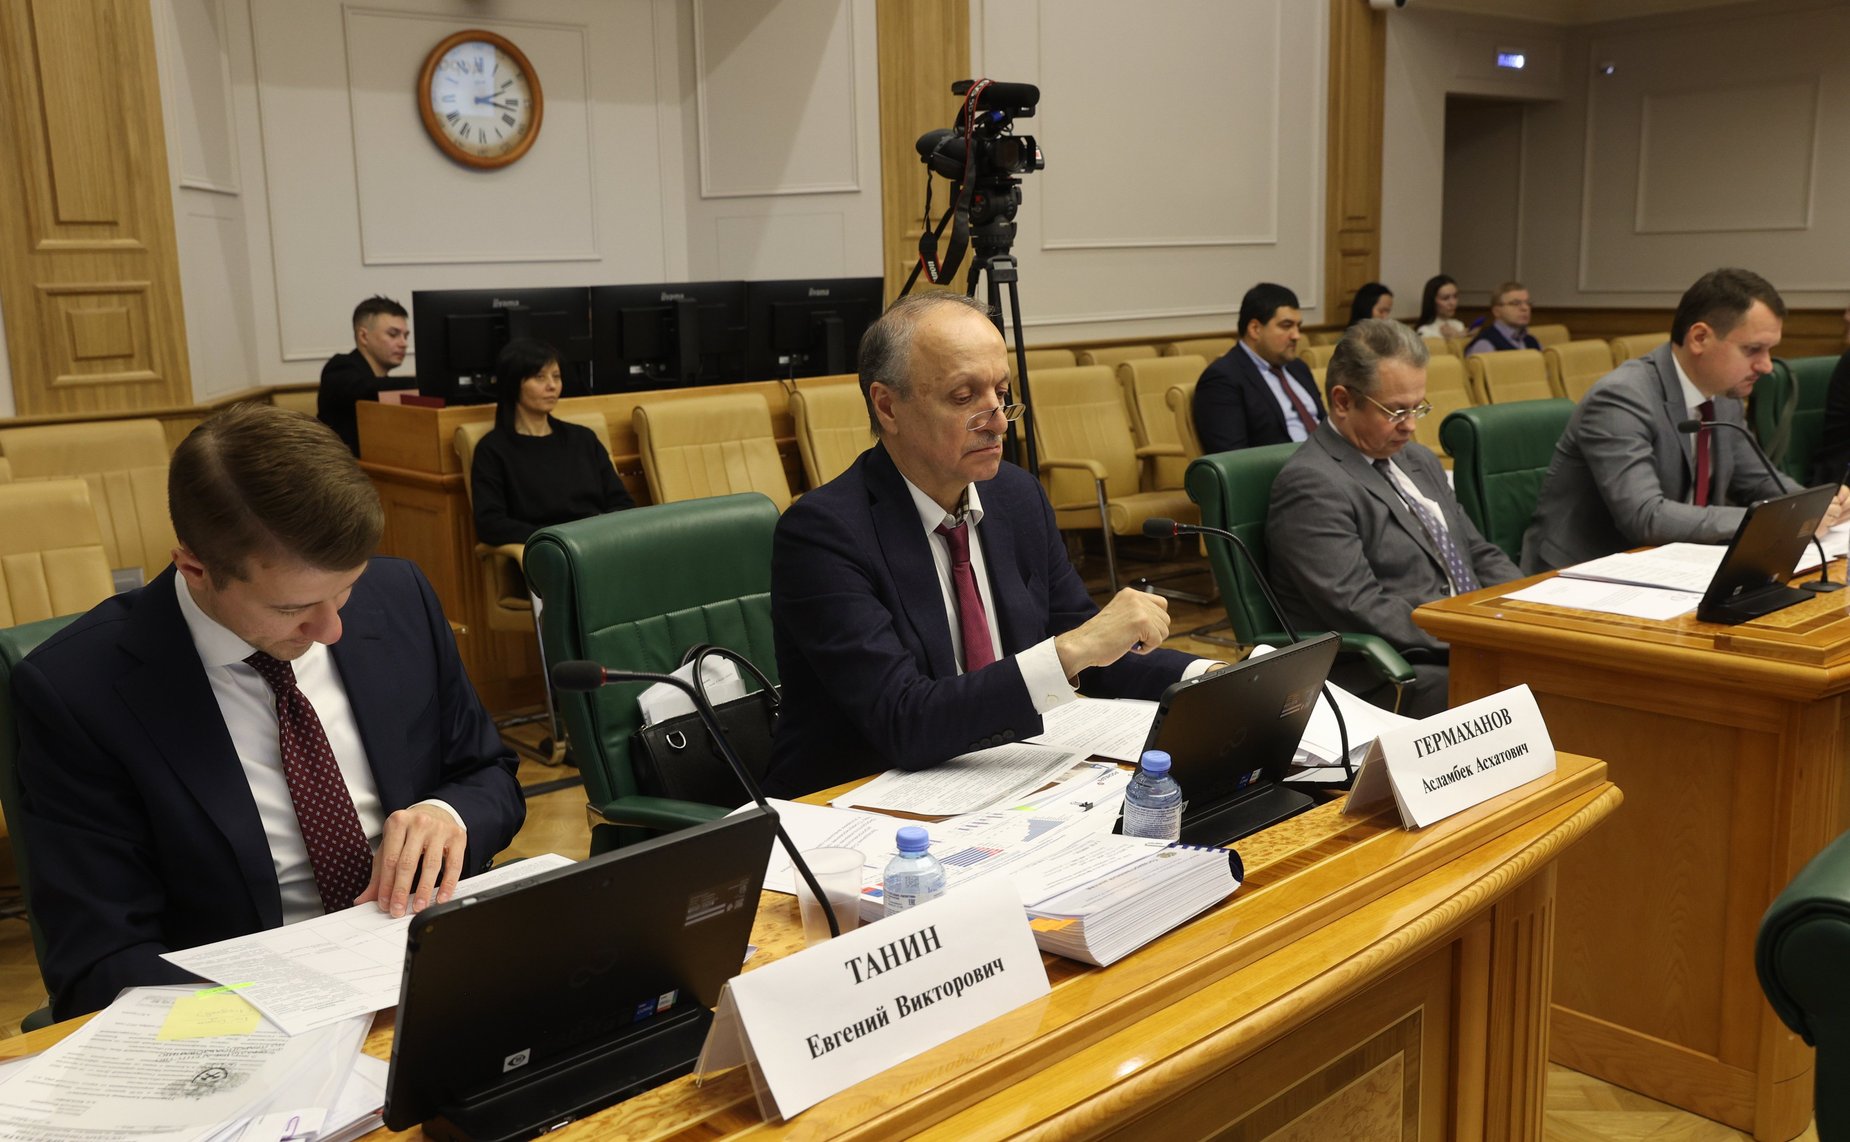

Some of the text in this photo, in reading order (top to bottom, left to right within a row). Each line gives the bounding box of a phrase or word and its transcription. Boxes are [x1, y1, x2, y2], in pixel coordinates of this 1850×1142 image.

[1413, 708, 1512, 759] ГЕРМАХАНОВ
[1422, 743, 1529, 794] Асламбек Асхатович
[844, 925, 943, 985] ТАНИН
[805, 957, 1005, 1060] Евгений Викторович
